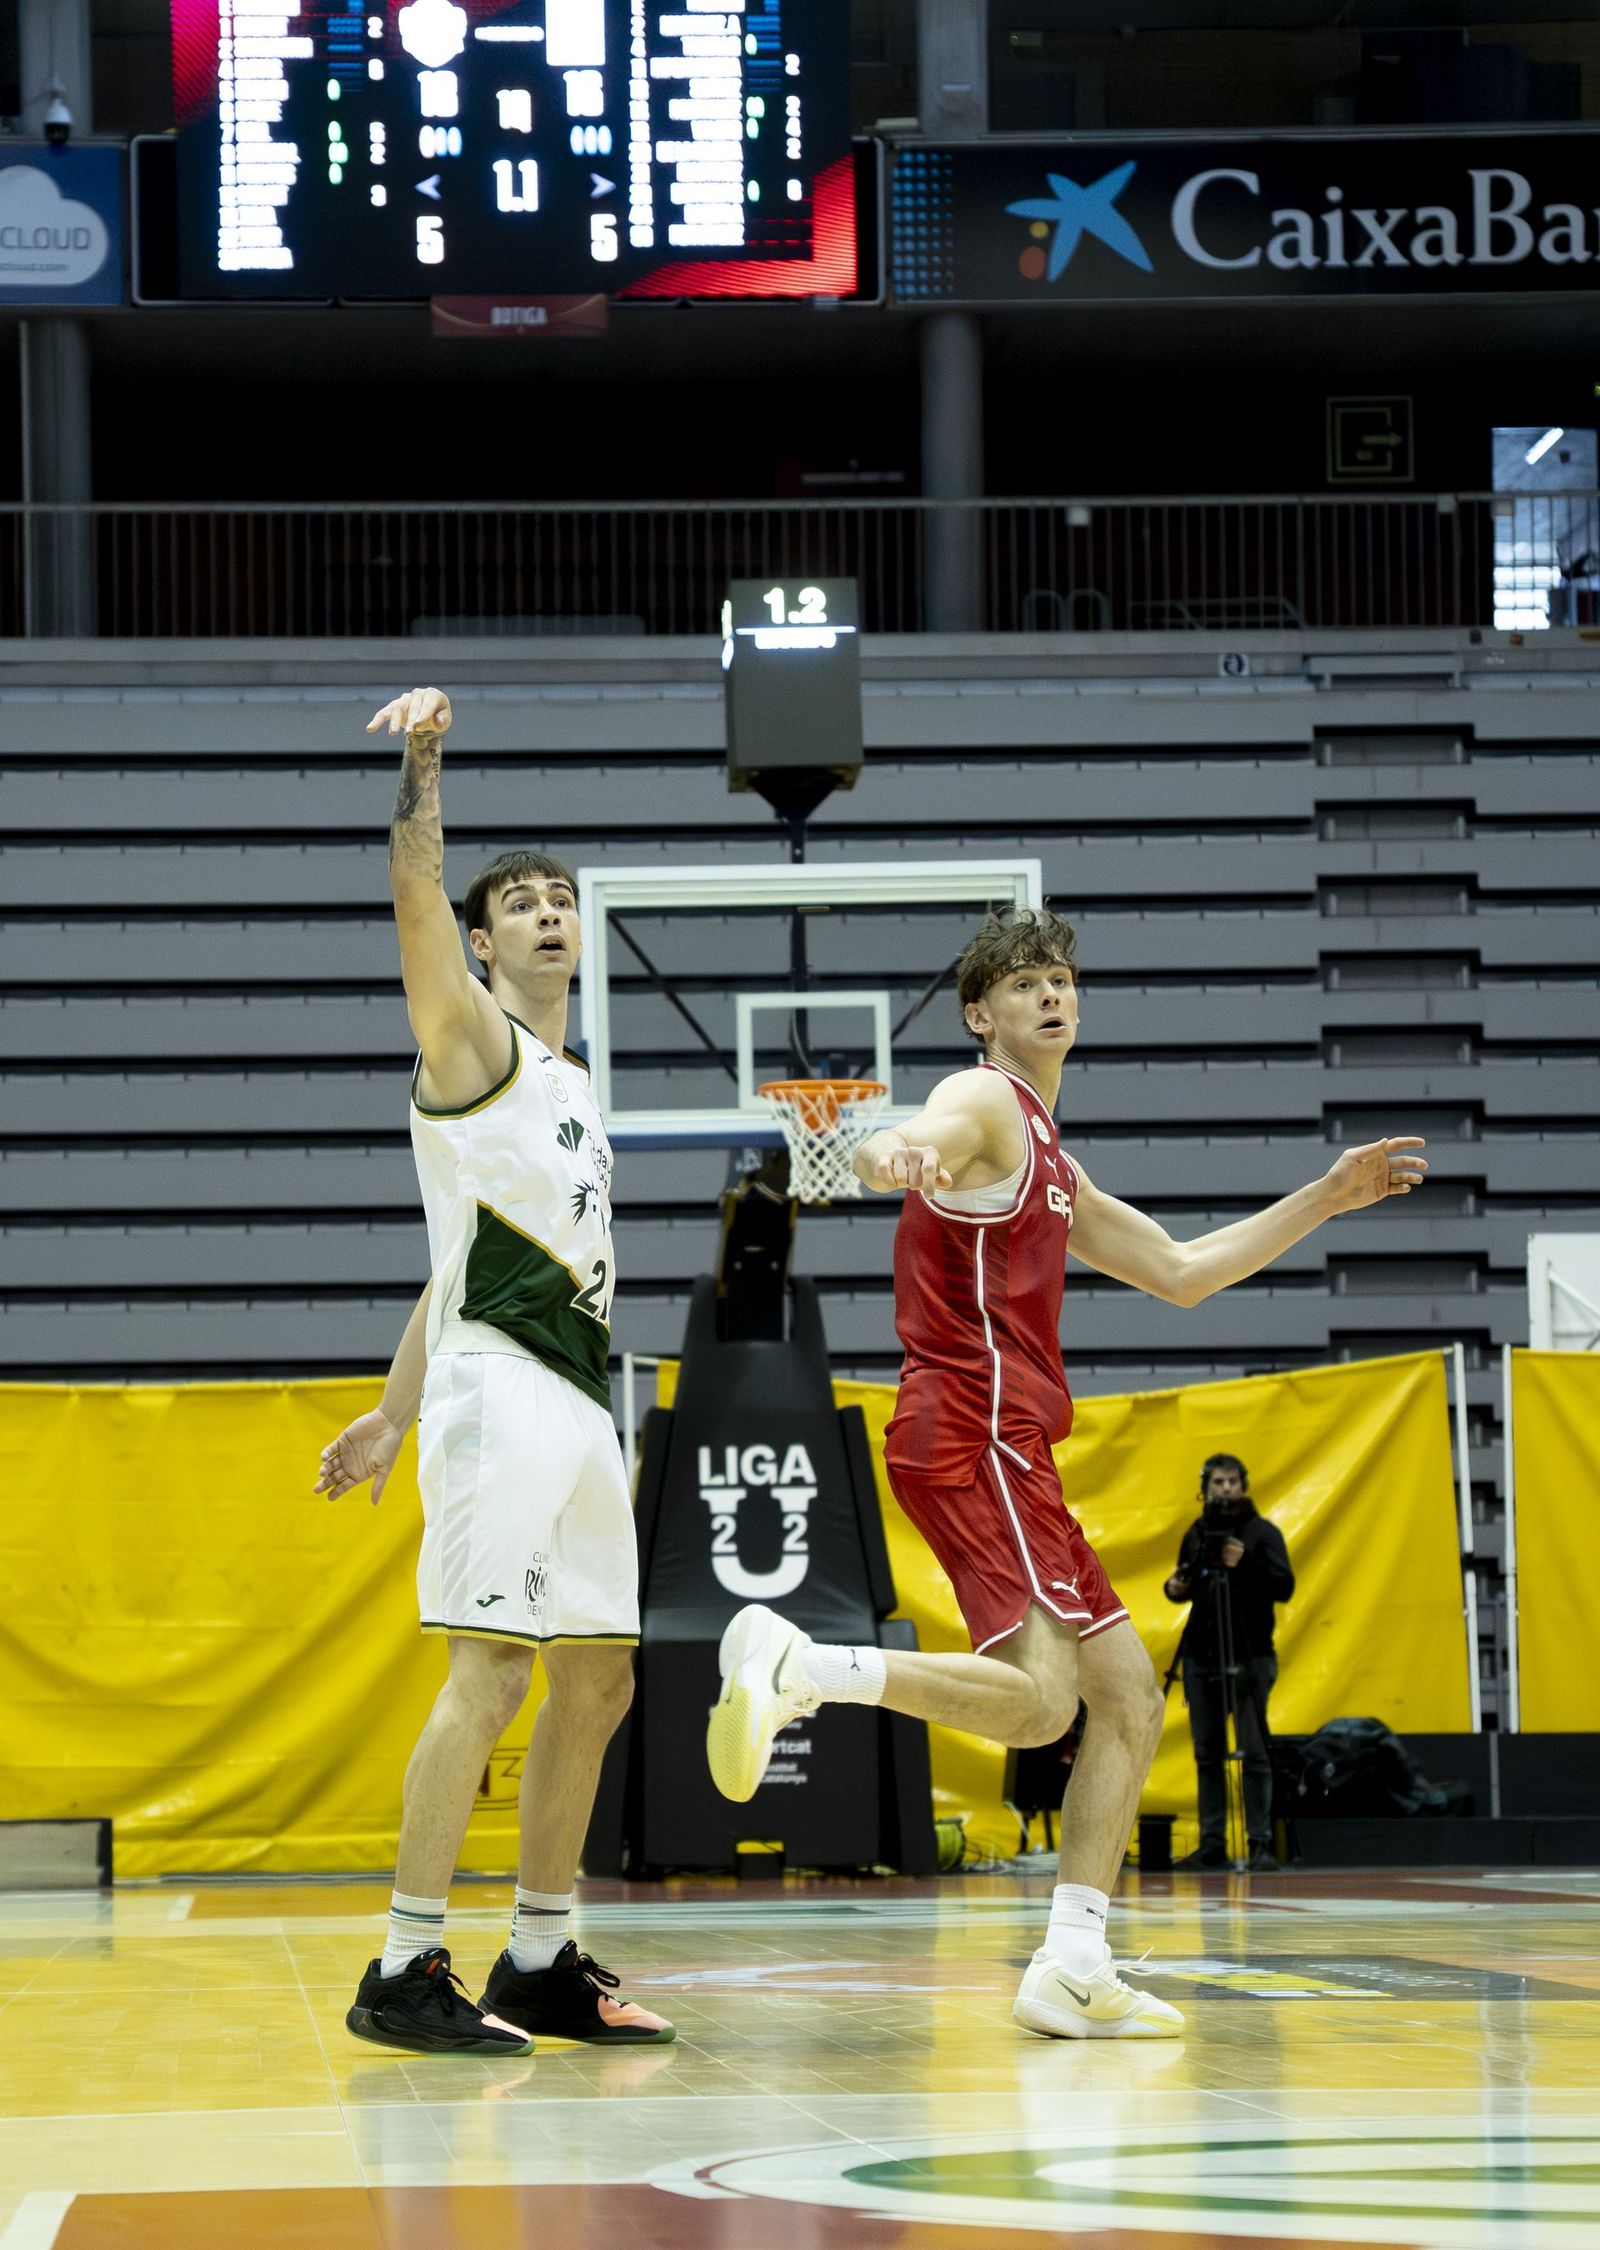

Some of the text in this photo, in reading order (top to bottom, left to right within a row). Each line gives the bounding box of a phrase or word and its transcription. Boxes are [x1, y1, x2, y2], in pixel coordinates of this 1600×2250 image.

[416, 216, 444, 264] 5
[590, 213, 618, 262] 5
[1171, 168, 1600, 269] CaixaBa
[763, 586, 828, 624] 1.2
[698, 1443, 817, 1487] LIGA
